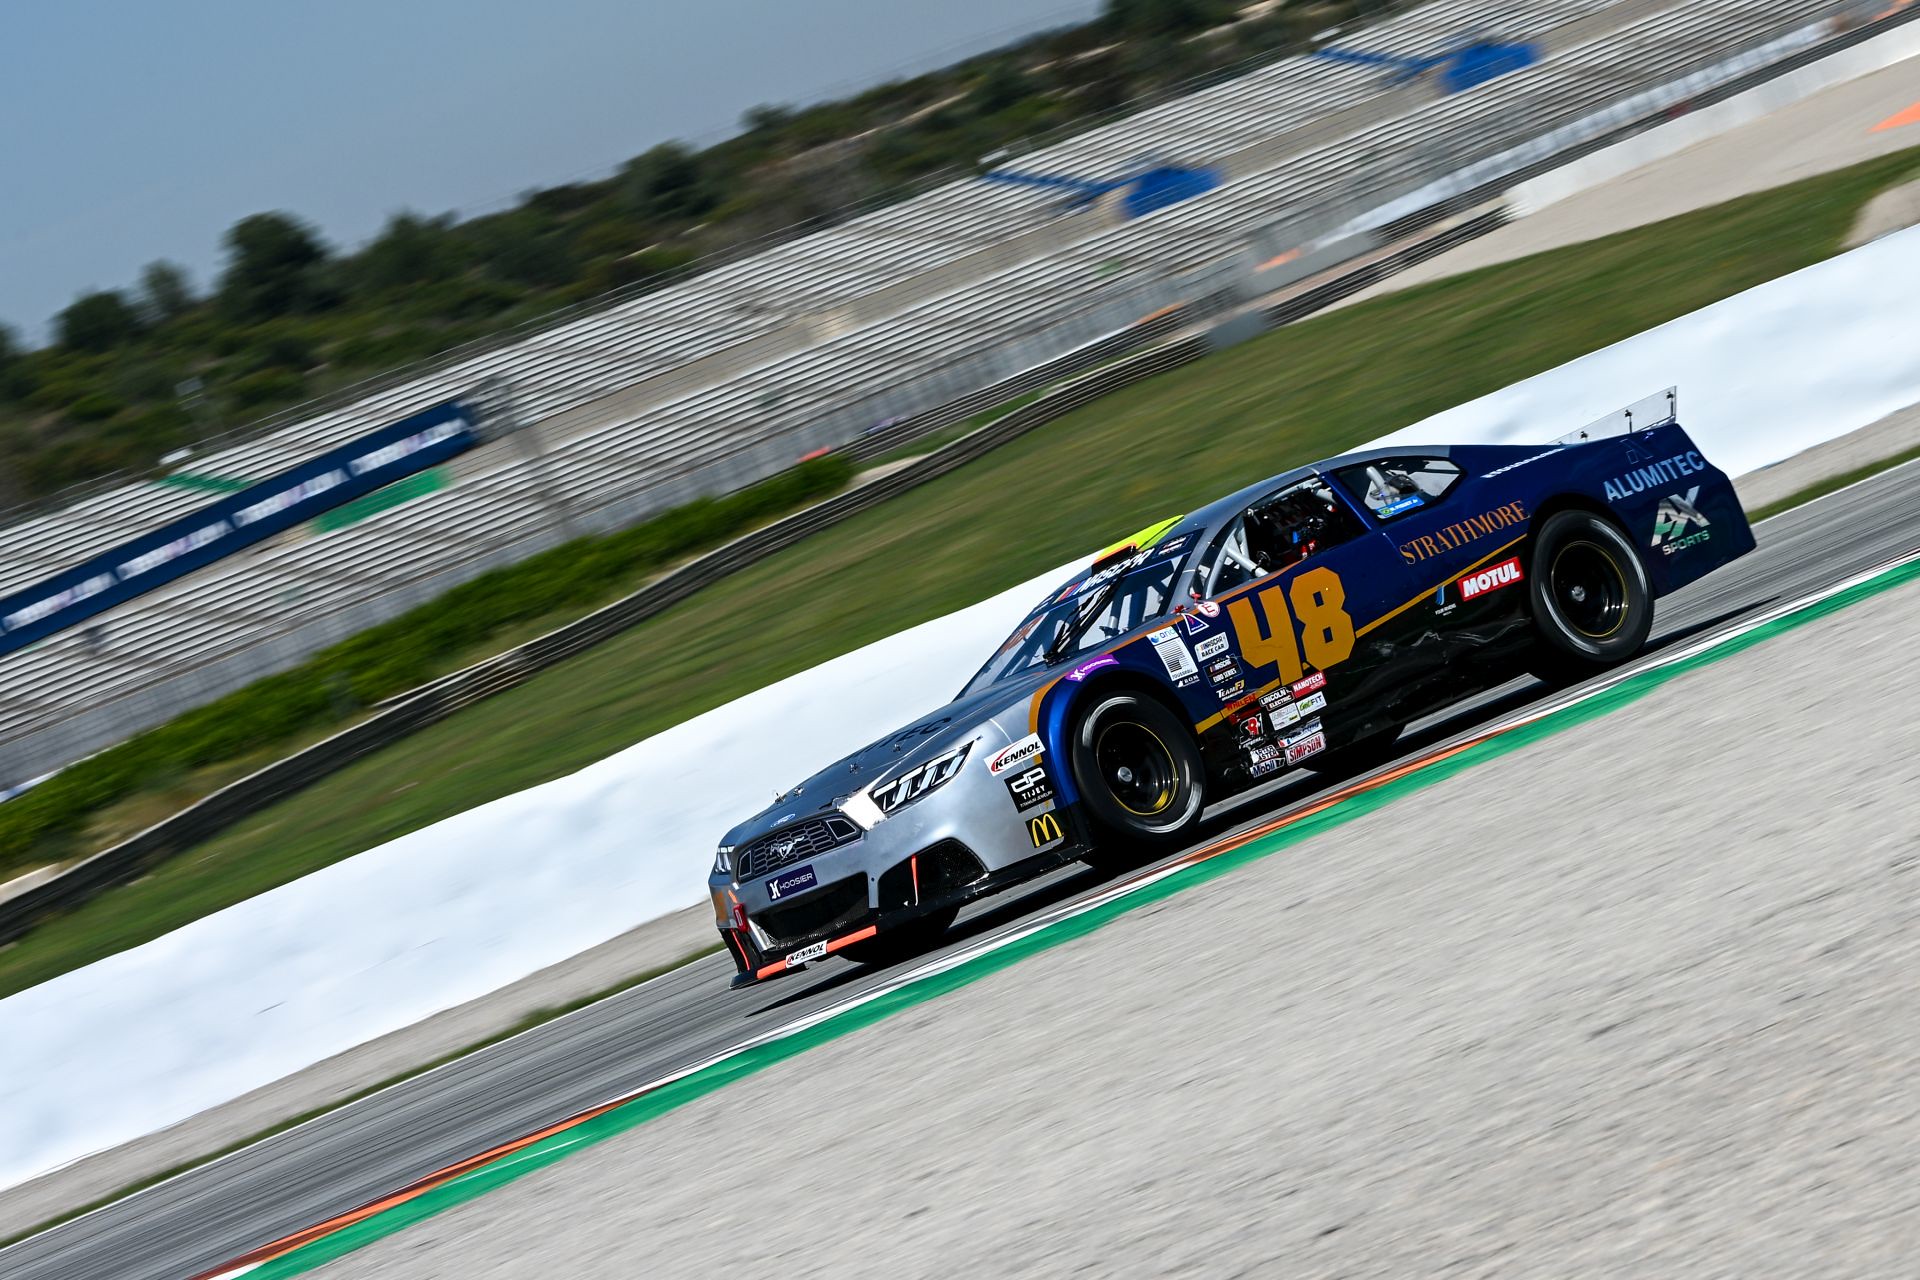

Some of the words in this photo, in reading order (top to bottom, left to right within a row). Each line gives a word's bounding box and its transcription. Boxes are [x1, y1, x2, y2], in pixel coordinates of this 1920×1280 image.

[1603, 450, 1705, 504] ALUMITEC
[1399, 500, 1532, 565] STRATHMORE
[1662, 530, 1710, 556] SPORTS
[1462, 561, 1521, 598] MOTUL
[1226, 566, 1356, 687] 48
[1214, 643, 1226, 653] CAR
[1293, 672, 1323, 693] NANOTECH
[1260, 688, 1287, 706] LINCOLN
[1269, 694, 1292, 709] ELECTRIC
[995, 741, 1041, 770] KENNOL
[1289, 735, 1323, 763] SIMPSON
[1252, 759, 1275, 778] Mobil
[1021, 784, 1046, 800] TIJEY
[779, 872, 814, 892] HOOSIER
[790, 942, 826, 965] KENNOL
